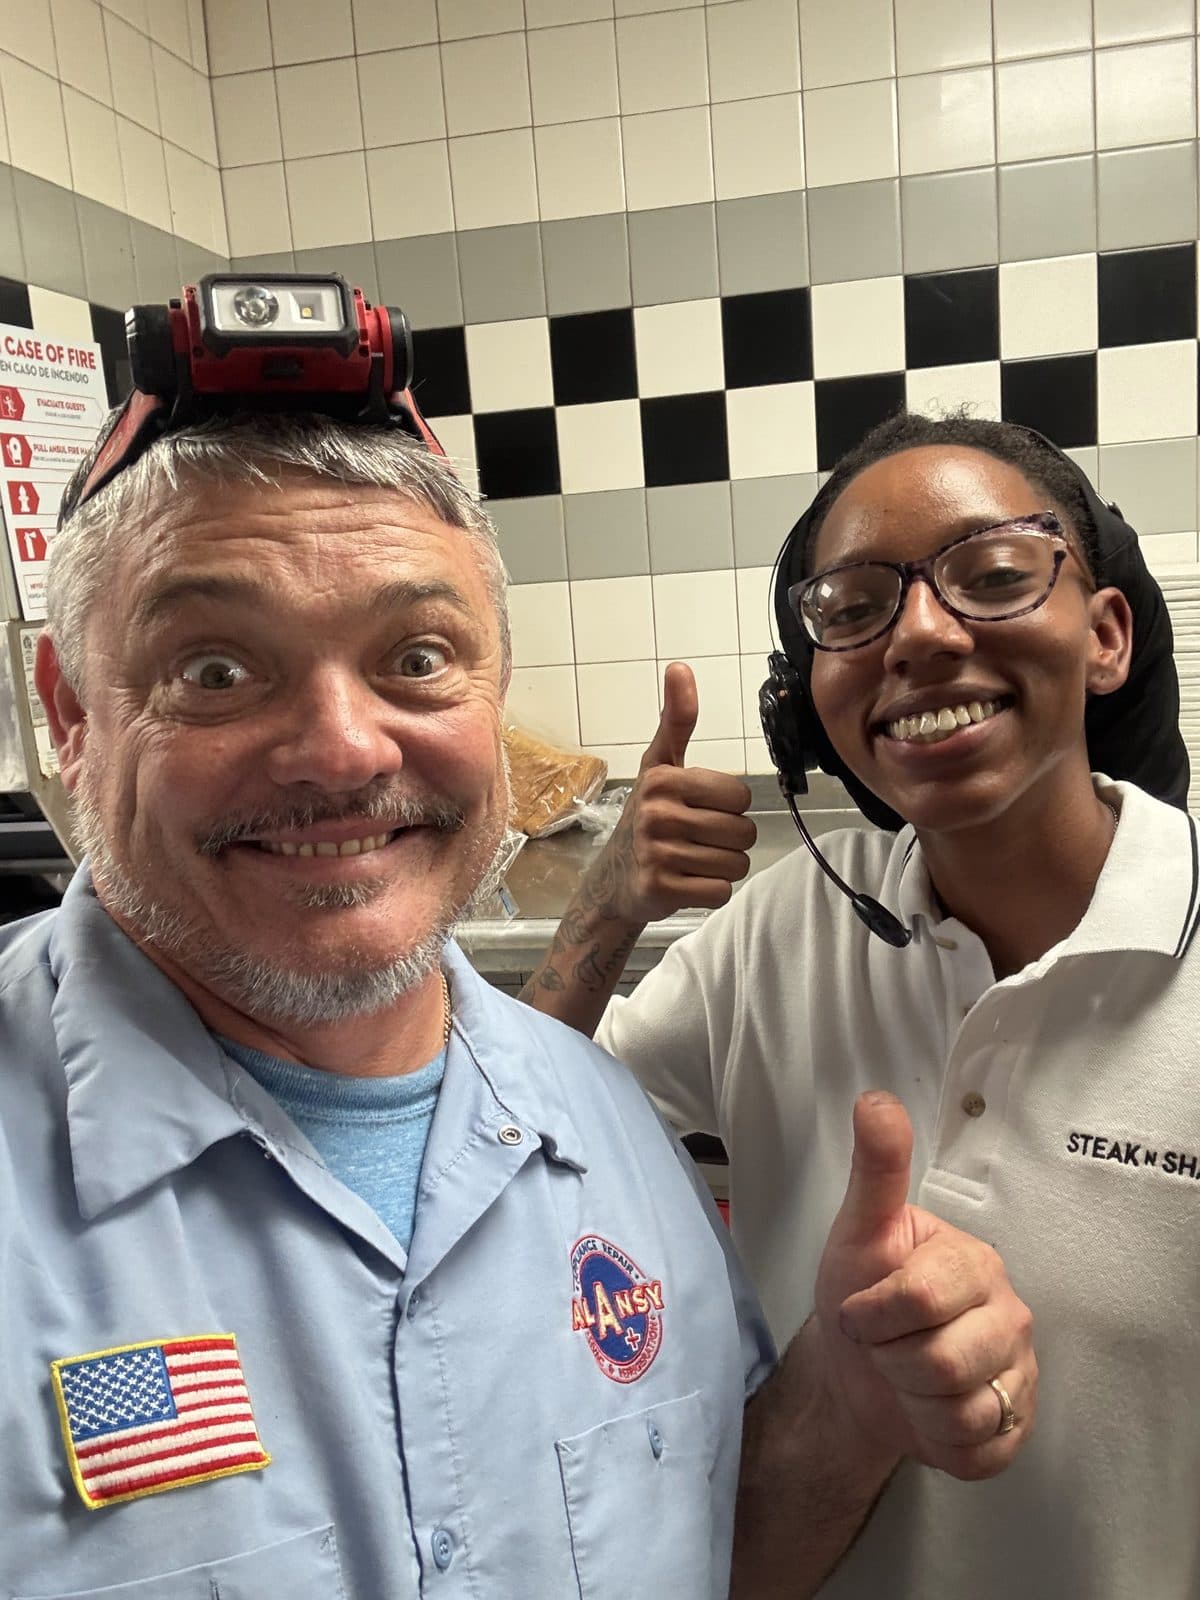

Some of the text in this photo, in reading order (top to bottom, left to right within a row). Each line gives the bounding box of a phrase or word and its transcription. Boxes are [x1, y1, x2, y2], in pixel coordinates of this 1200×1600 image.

[4, 335, 97, 370] CASE OF FIRE
[13, 362, 37, 377] CASO
[38, 366, 50, 378] DE
[51, 369, 89, 384] INCENDIO
[1067, 1132, 1141, 1167] STEAK
[1144, 1149, 1158, 1166] N
[602, 1243, 634, 1274] REPAIR
[571, 1280, 665, 1341] ALANSY
